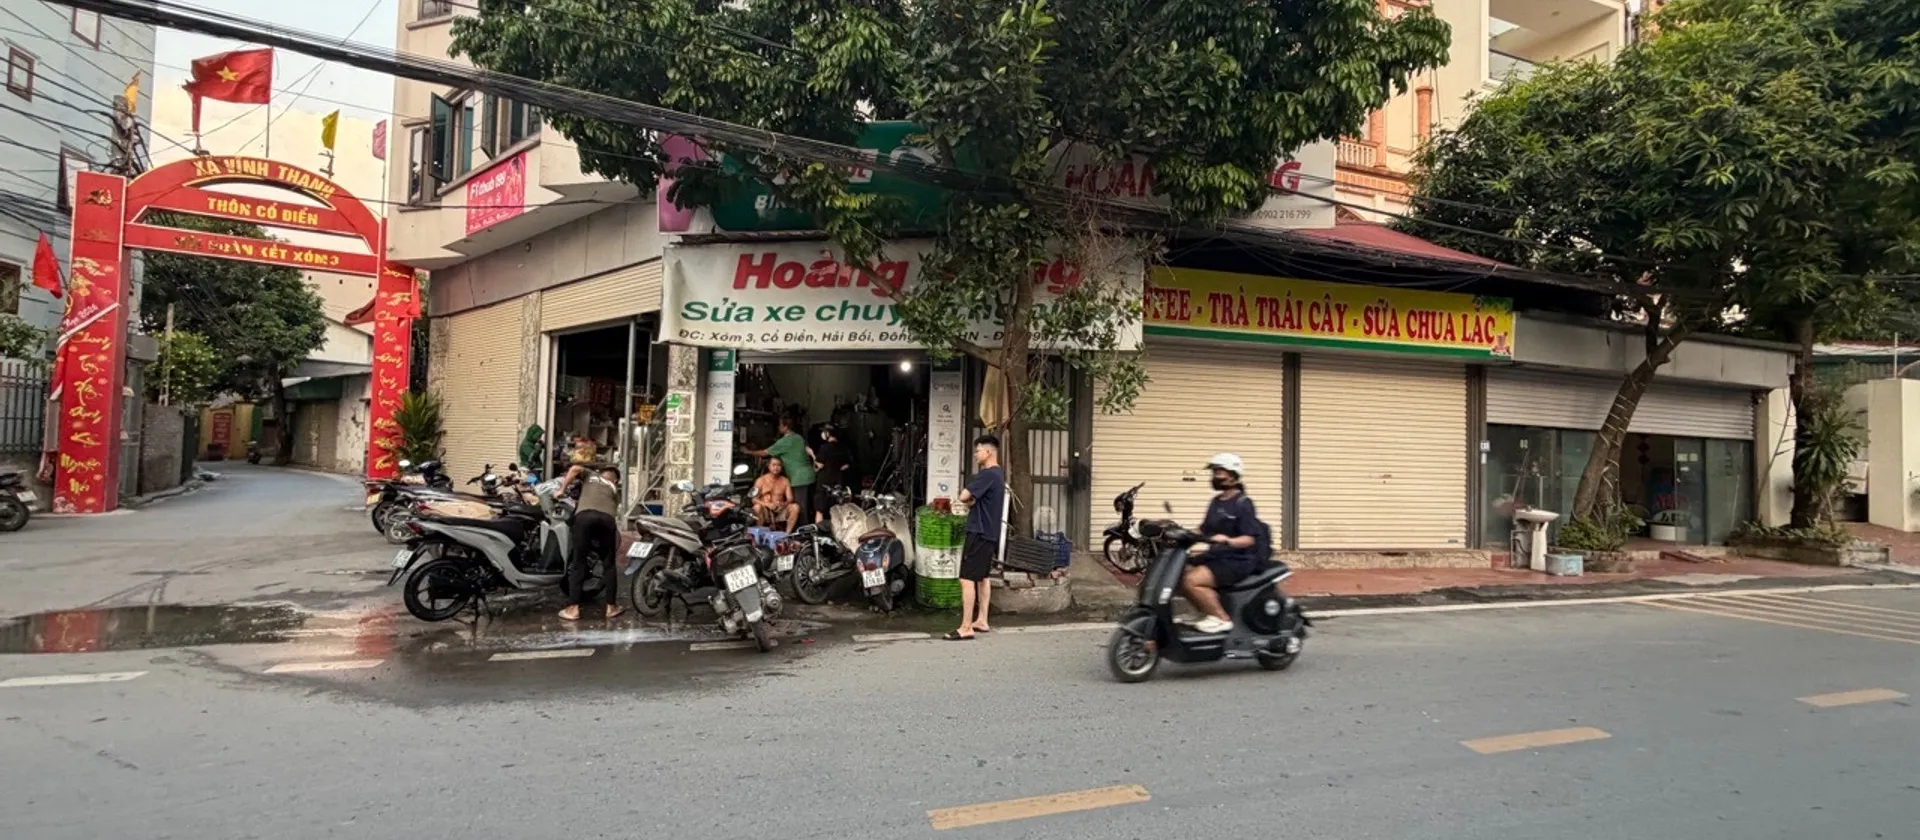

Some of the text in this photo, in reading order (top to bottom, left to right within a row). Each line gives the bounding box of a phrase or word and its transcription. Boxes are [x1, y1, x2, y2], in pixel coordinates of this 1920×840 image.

[278, 165, 336, 200] THANH
[207, 197, 319, 226] THÔN CỔ ĐIỂN
[1280, 210, 1294, 219] 216
[1296, 210, 1312, 219] 799
[681, 297, 906, 327] Sửa xe chuy
[1143, 287, 1192, 322] FFEE
[1208, 284, 1250, 326] TRÀ
[1255, 290, 1304, 331] TRÁI
[1308, 293, 1348, 334] CÂY
[1363, 297, 1400, 337] SỮA
[1406, 308, 1456, 342] CHUA
[678, 328, 705, 341] ĐC:
[709, 331, 742, 343] Xóm
